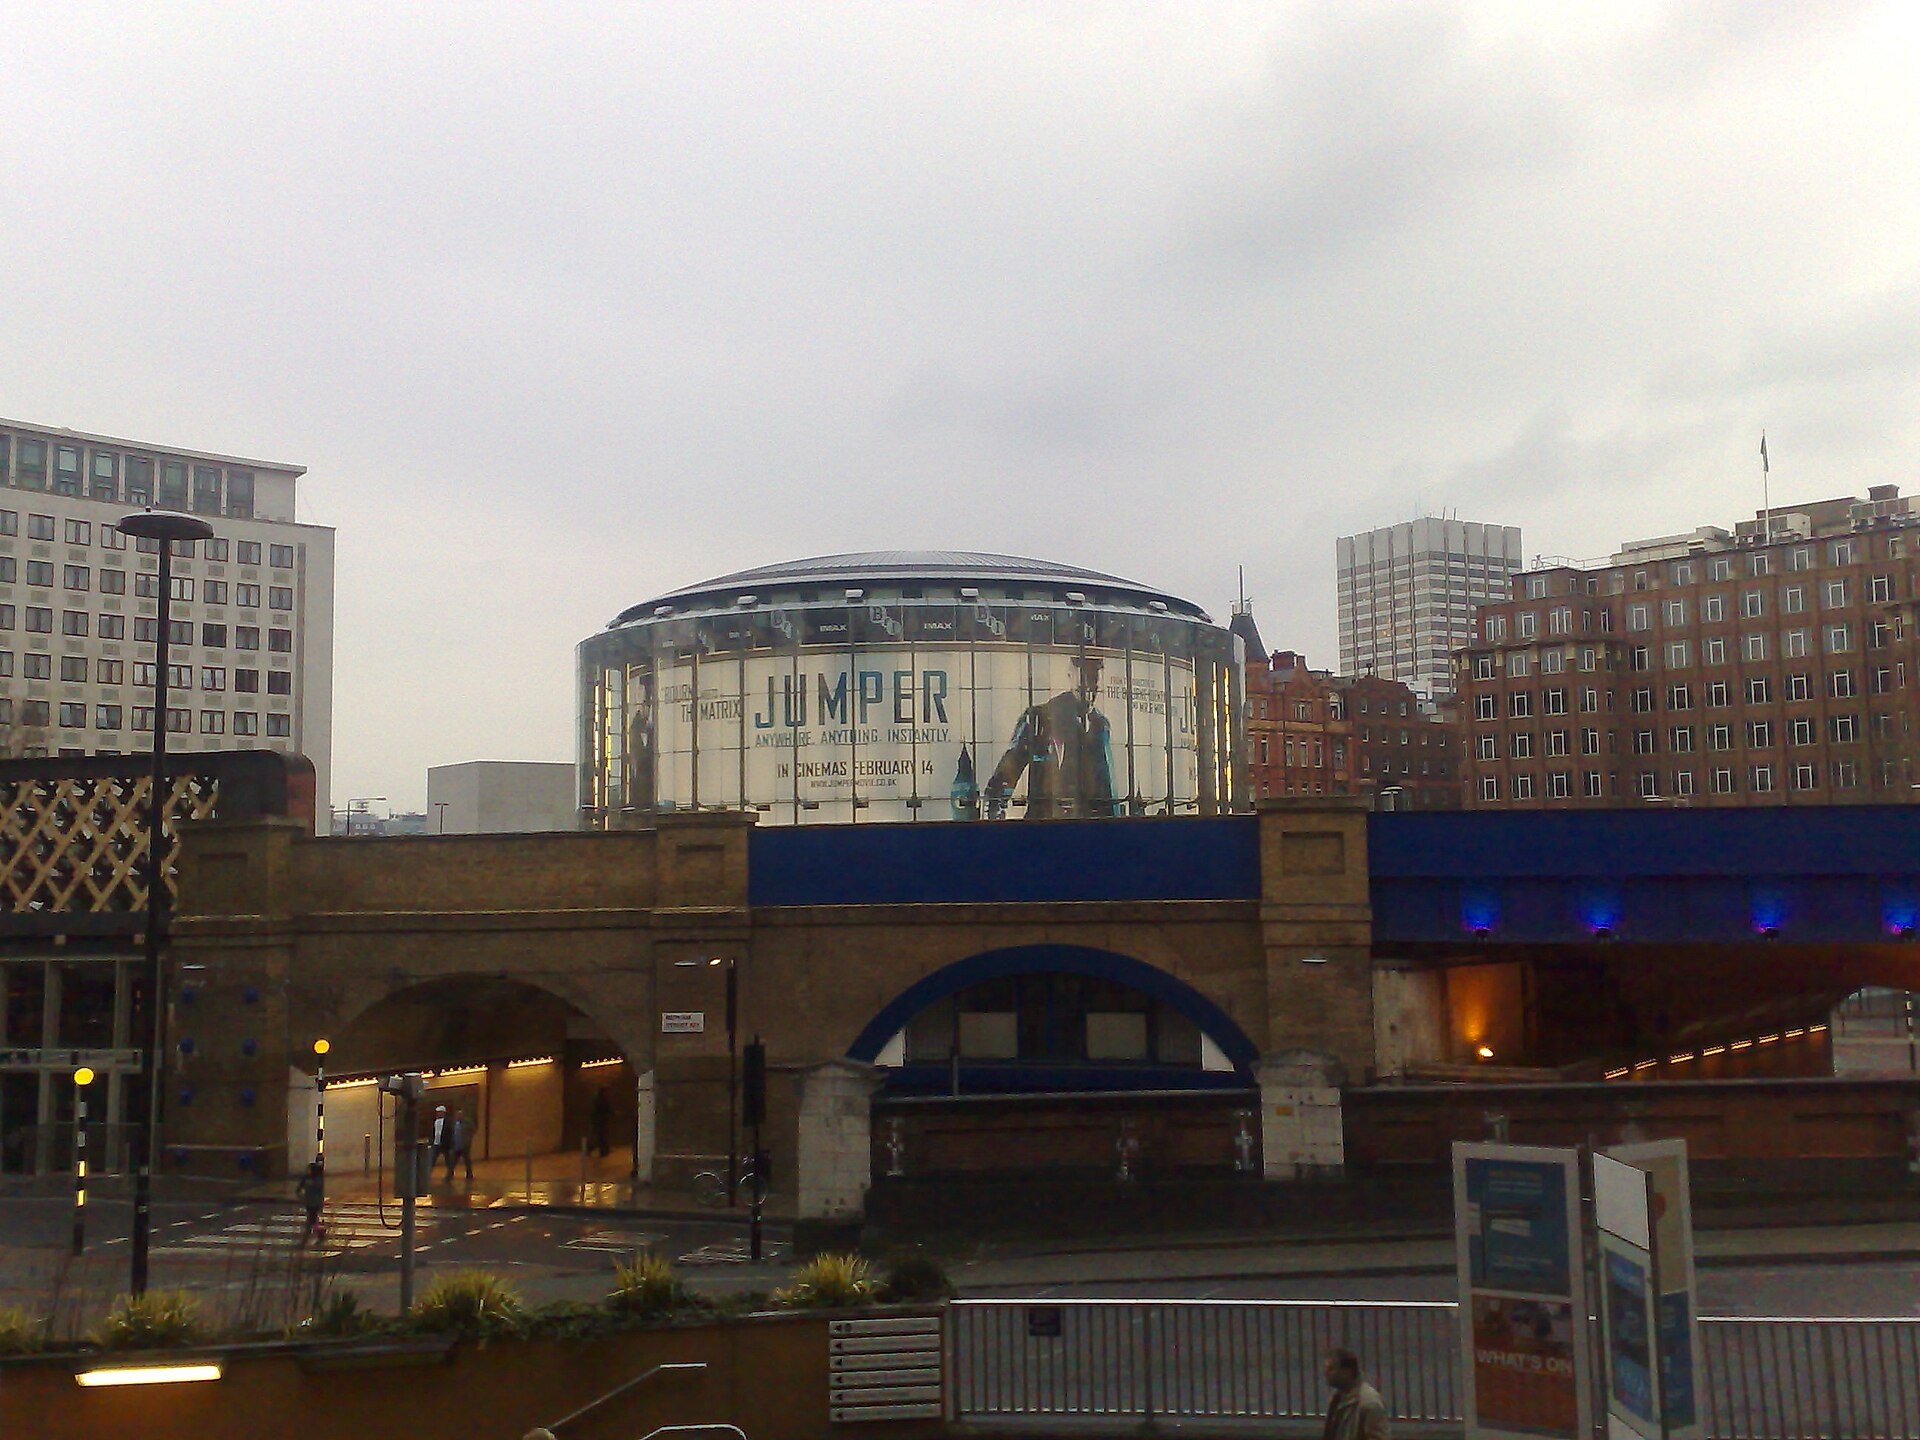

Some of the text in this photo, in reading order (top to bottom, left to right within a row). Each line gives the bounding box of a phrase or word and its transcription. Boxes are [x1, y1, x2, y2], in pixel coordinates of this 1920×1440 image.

[924, 622, 952, 630] IMAX
[754, 669, 949, 729] JUMPER
[778, 759, 934, 778] IN CINEMAS FEBRUARY 14
[1476, 1348, 1573, 1374] WHAT'S ON
